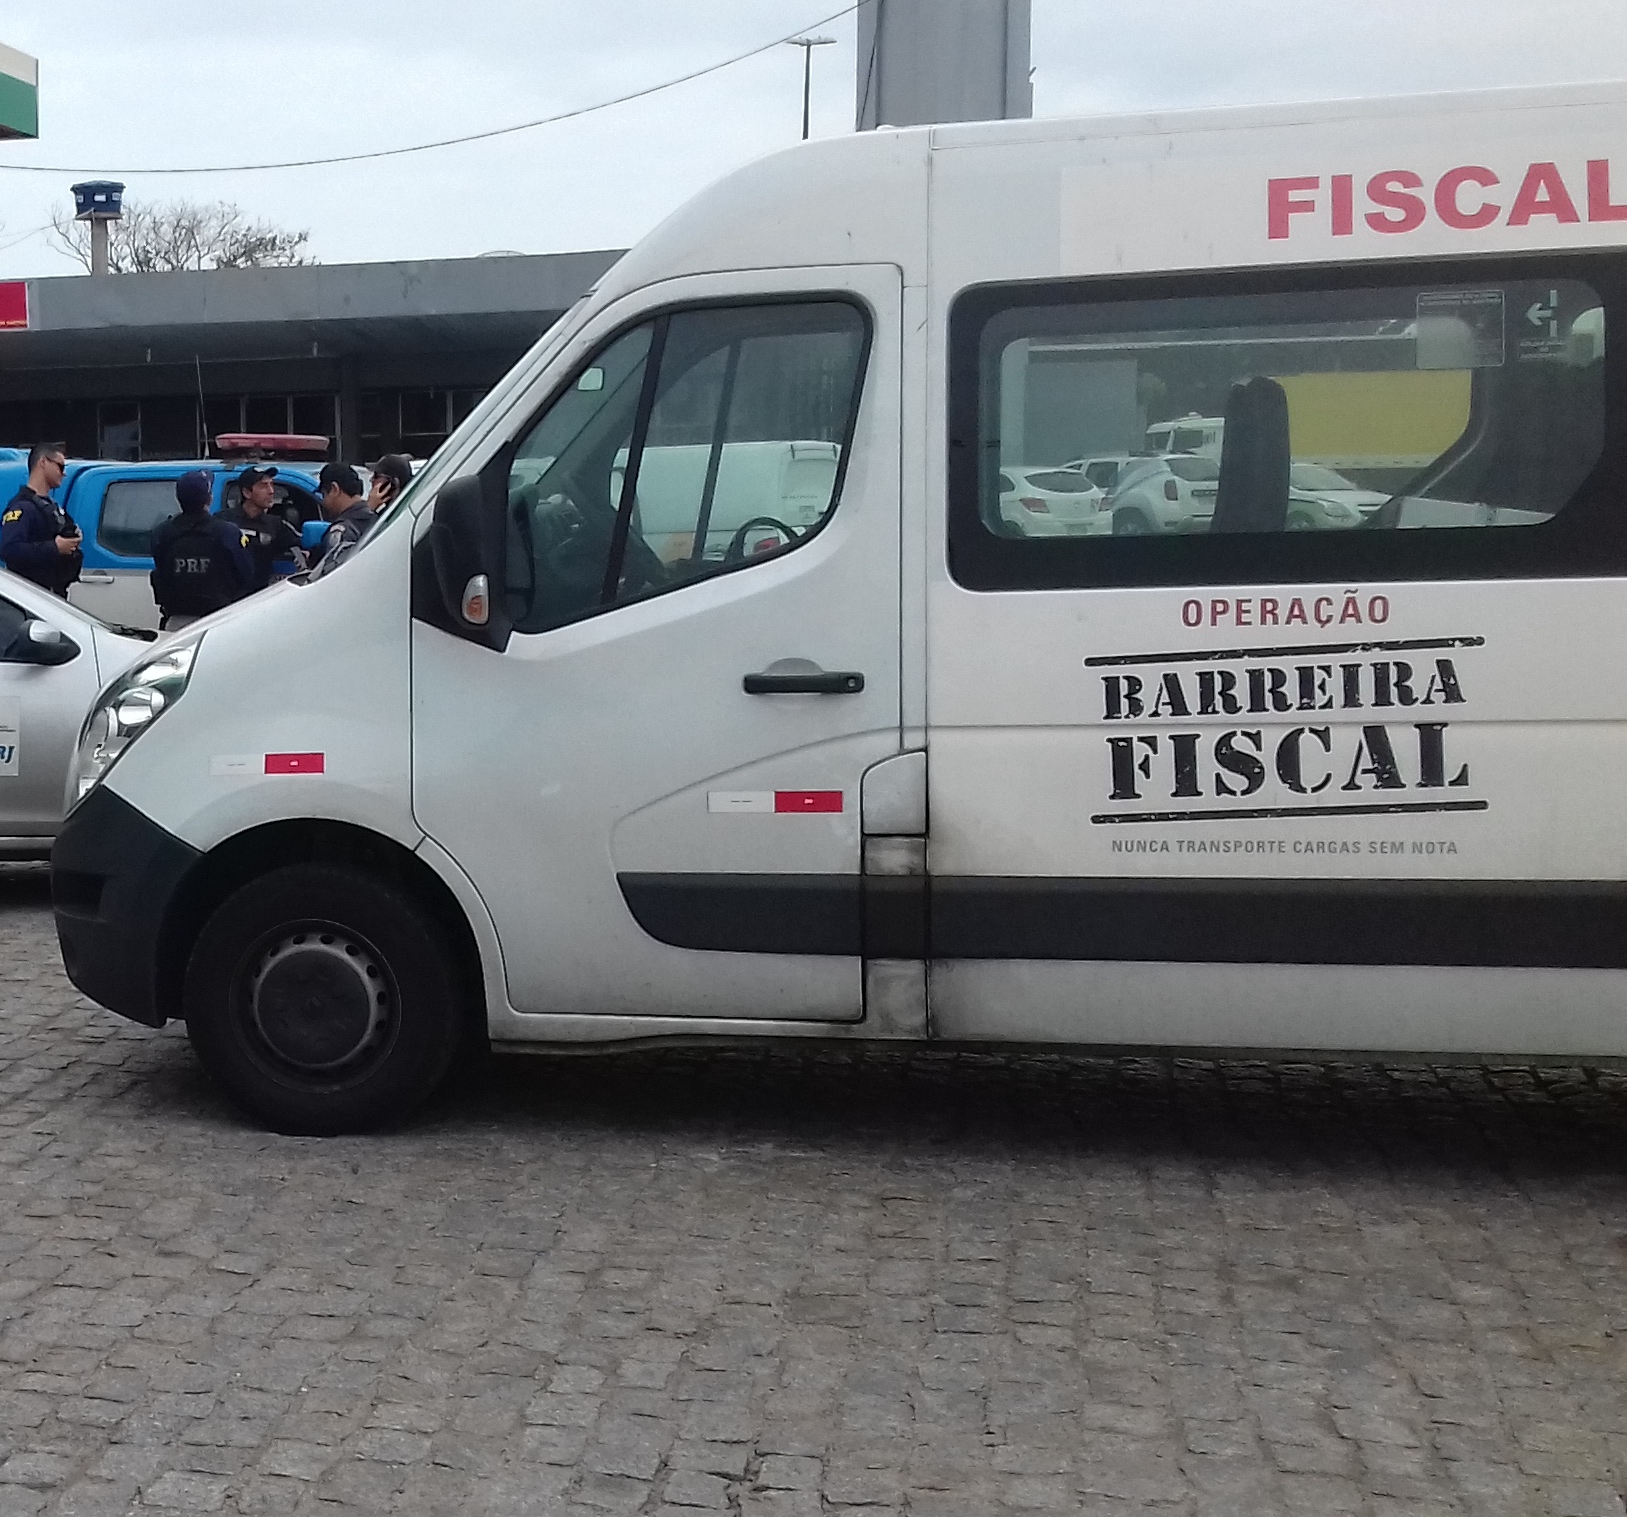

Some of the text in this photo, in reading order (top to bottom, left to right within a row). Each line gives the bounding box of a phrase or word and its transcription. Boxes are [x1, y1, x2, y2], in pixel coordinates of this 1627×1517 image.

[1267, 158, 1627, 240] FISCAL
[175, 558, 211, 573] PRF
[1181, 589, 1391, 628] OPERAÇÃO
[1100, 658, 1467, 720] BARREIRA
[1105, 723, 1470, 800] FISCAL
[1112, 839, 1458, 855] NUNCA TRANSPORTE CARGAS SEM NOTA
